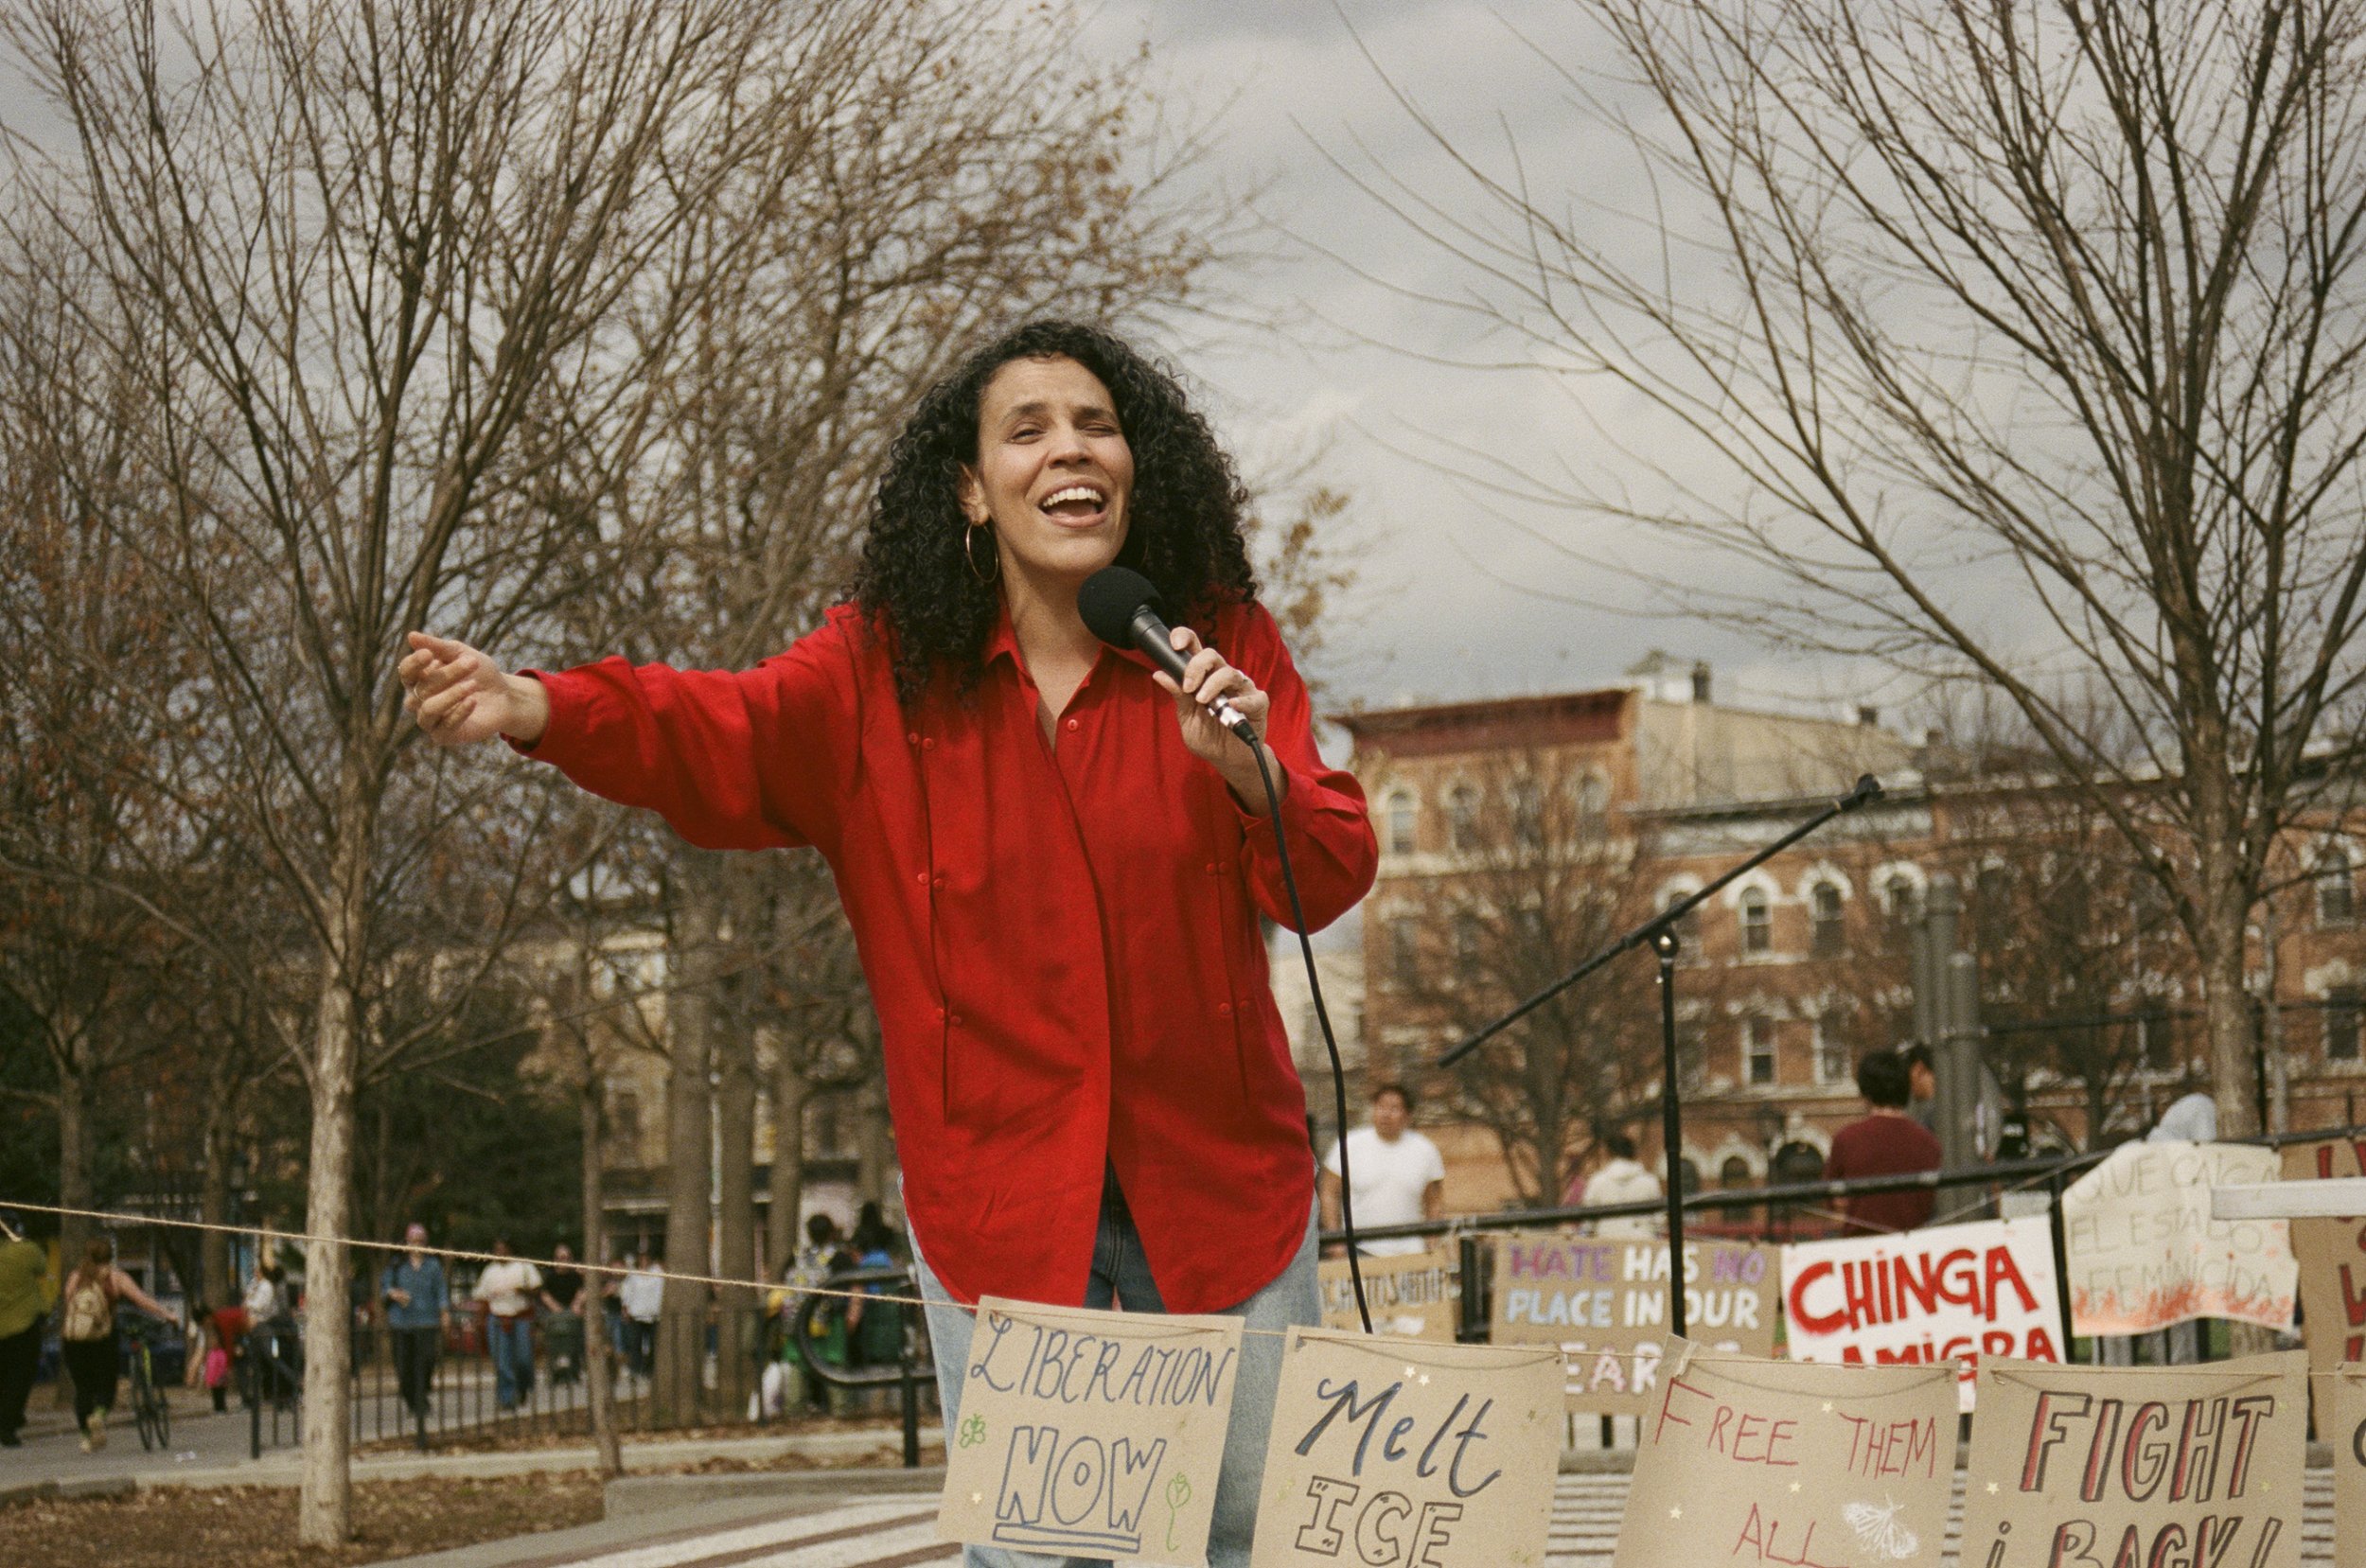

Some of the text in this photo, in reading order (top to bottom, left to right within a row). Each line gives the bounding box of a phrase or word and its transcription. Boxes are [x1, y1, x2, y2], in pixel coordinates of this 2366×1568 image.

[1506, 1289, 1760, 1329] PLACE IN OUR
[1510, 1243, 1767, 1284] HATE HAS NO
[969, 1317, 1236, 1407] LIBERATION
[1294, 1377, 1502, 1498] Melt
[1654, 1377, 1936, 1480] FREE THEM
[2019, 1390, 2275, 1504] FIGHT
[996, 1426, 1167, 1532] NOW
[1295, 1475, 1464, 1568] ICE
[1733, 1502, 1850, 1568] ALL
